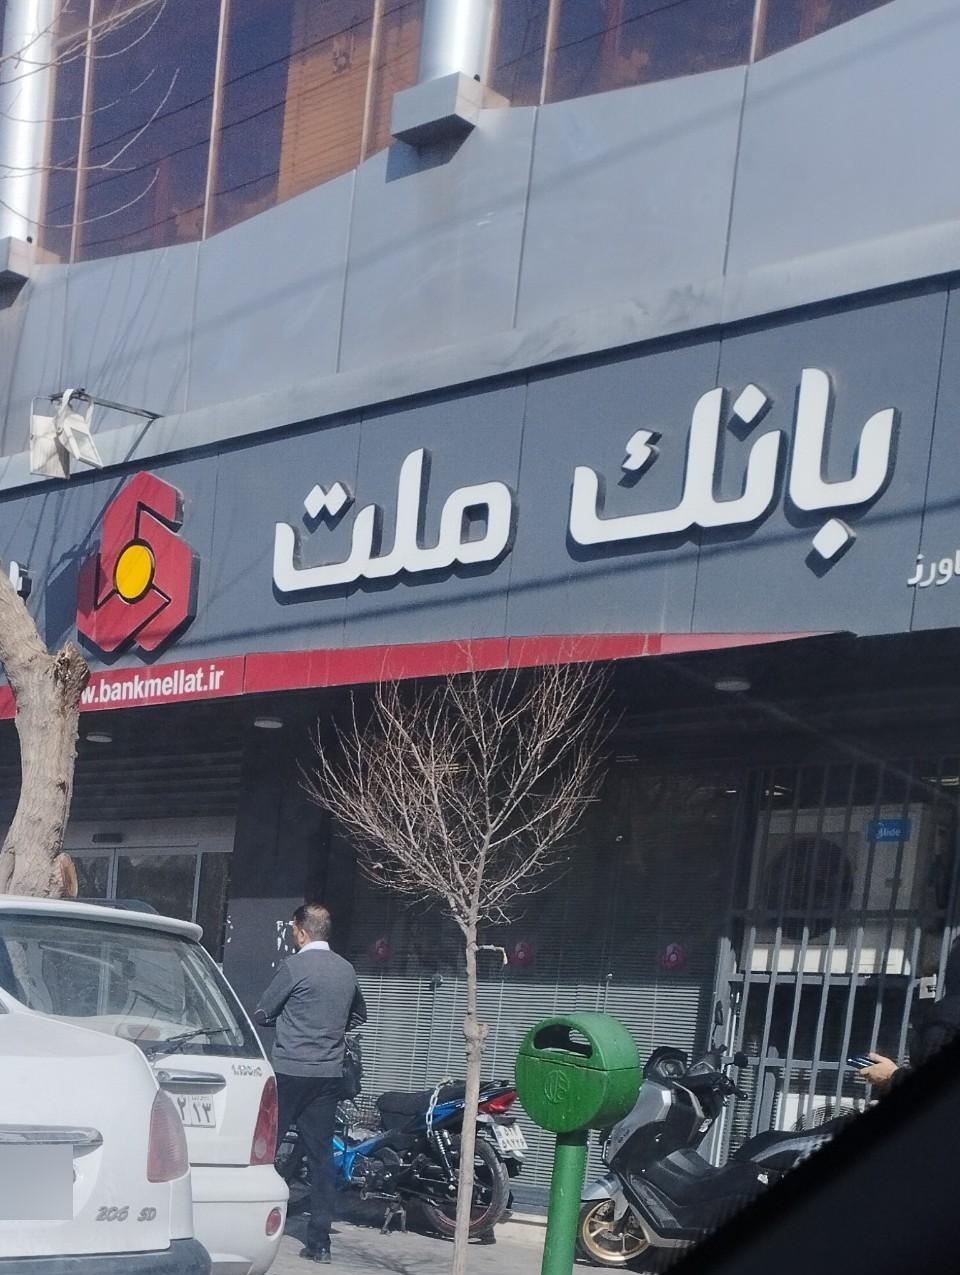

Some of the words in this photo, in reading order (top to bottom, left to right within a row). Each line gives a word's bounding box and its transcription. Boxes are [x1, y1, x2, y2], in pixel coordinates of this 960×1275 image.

[274, 448, 516, 592] ملت
[81, 665, 224, 704] w.bankmellat.ir
[96, 1206, 129, 1222] 206
[137, 1206, 157, 1222] SD
